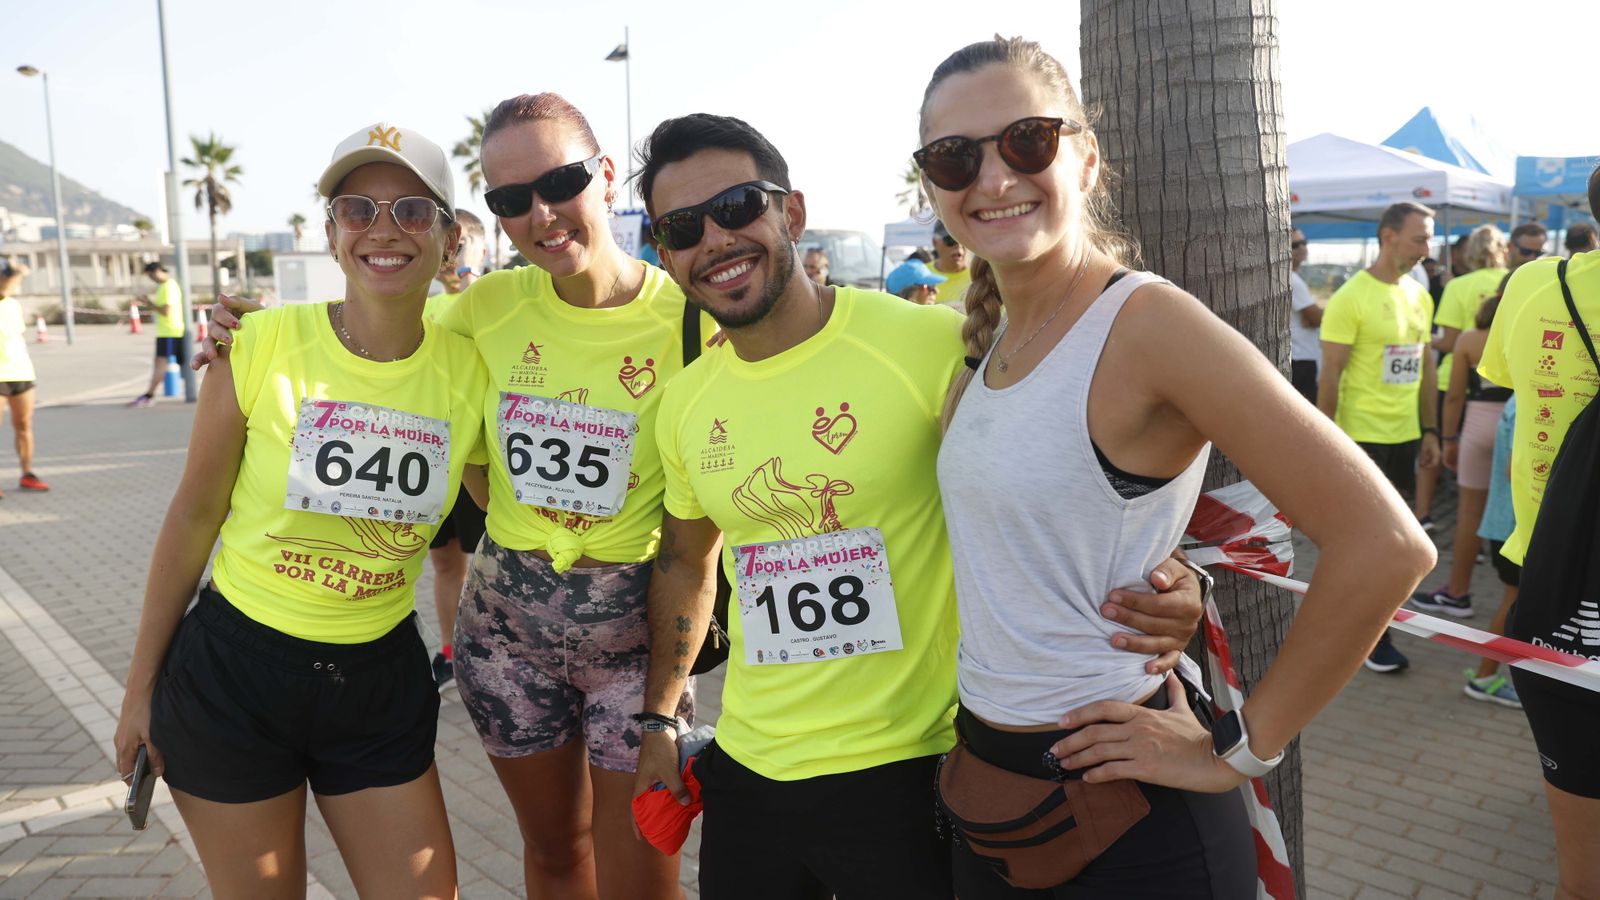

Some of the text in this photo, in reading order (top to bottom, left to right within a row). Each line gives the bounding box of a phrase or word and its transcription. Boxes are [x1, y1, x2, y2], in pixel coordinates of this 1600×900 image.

[330, 417, 366, 432] POR
[370, 423, 390, 436] LA
[350, 406, 436, 433] CARRERA
[514, 410, 546, 426] POR
[550, 416, 570, 429] LA
[531, 399, 622, 426] CARRERA
[315, 440, 430, 497] 640
[506, 432, 610, 488] 635
[768, 532, 870, 560] CARRERA
[274, 563, 316, 582] POR
[322, 574, 349, 594] LA
[280, 549, 406, 586] VII CARRERA
[755, 560, 784, 574] POR
[789, 558, 810, 571] LA
[756, 574, 870, 634] 168
